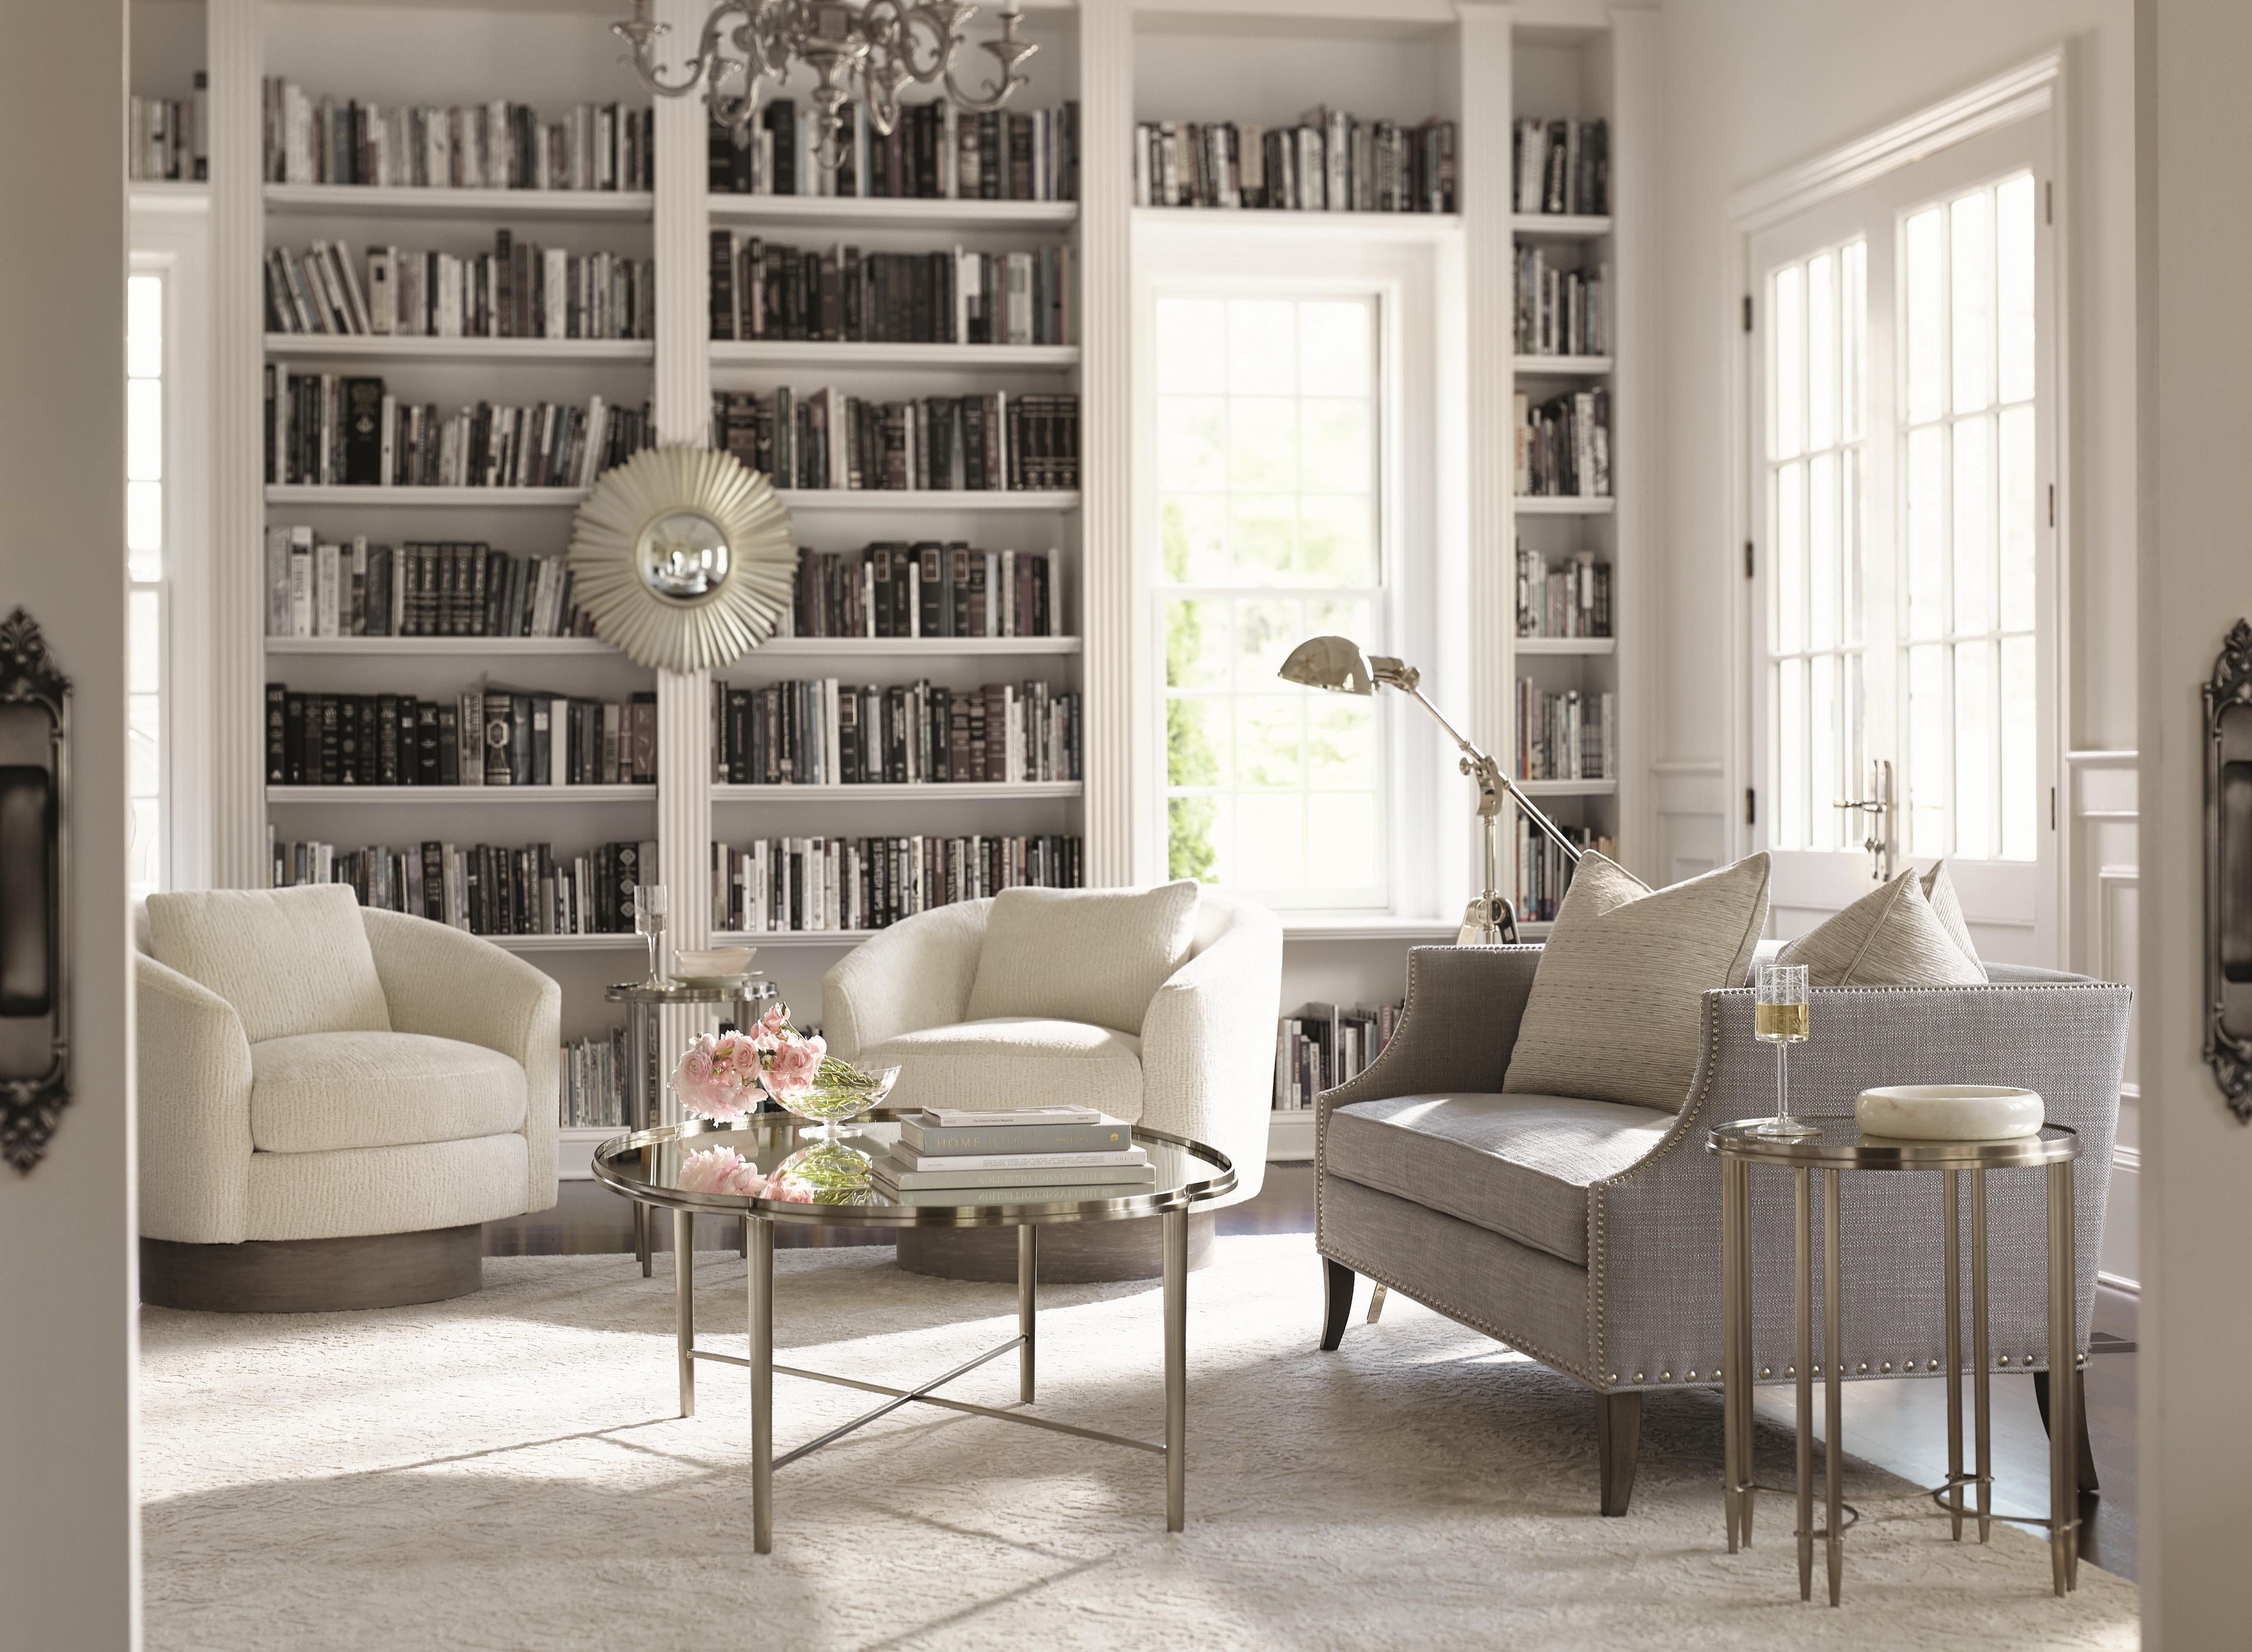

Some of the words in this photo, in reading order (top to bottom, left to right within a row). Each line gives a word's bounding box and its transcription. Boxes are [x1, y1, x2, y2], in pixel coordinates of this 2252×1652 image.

[937, 1137, 980, 1149] HOME
[978, 1175, 1037, 1184] COLLECTION
[1040, 1173, 1077, 1182] CLASSIC
[1080, 1172, 1098, 1181] THE
